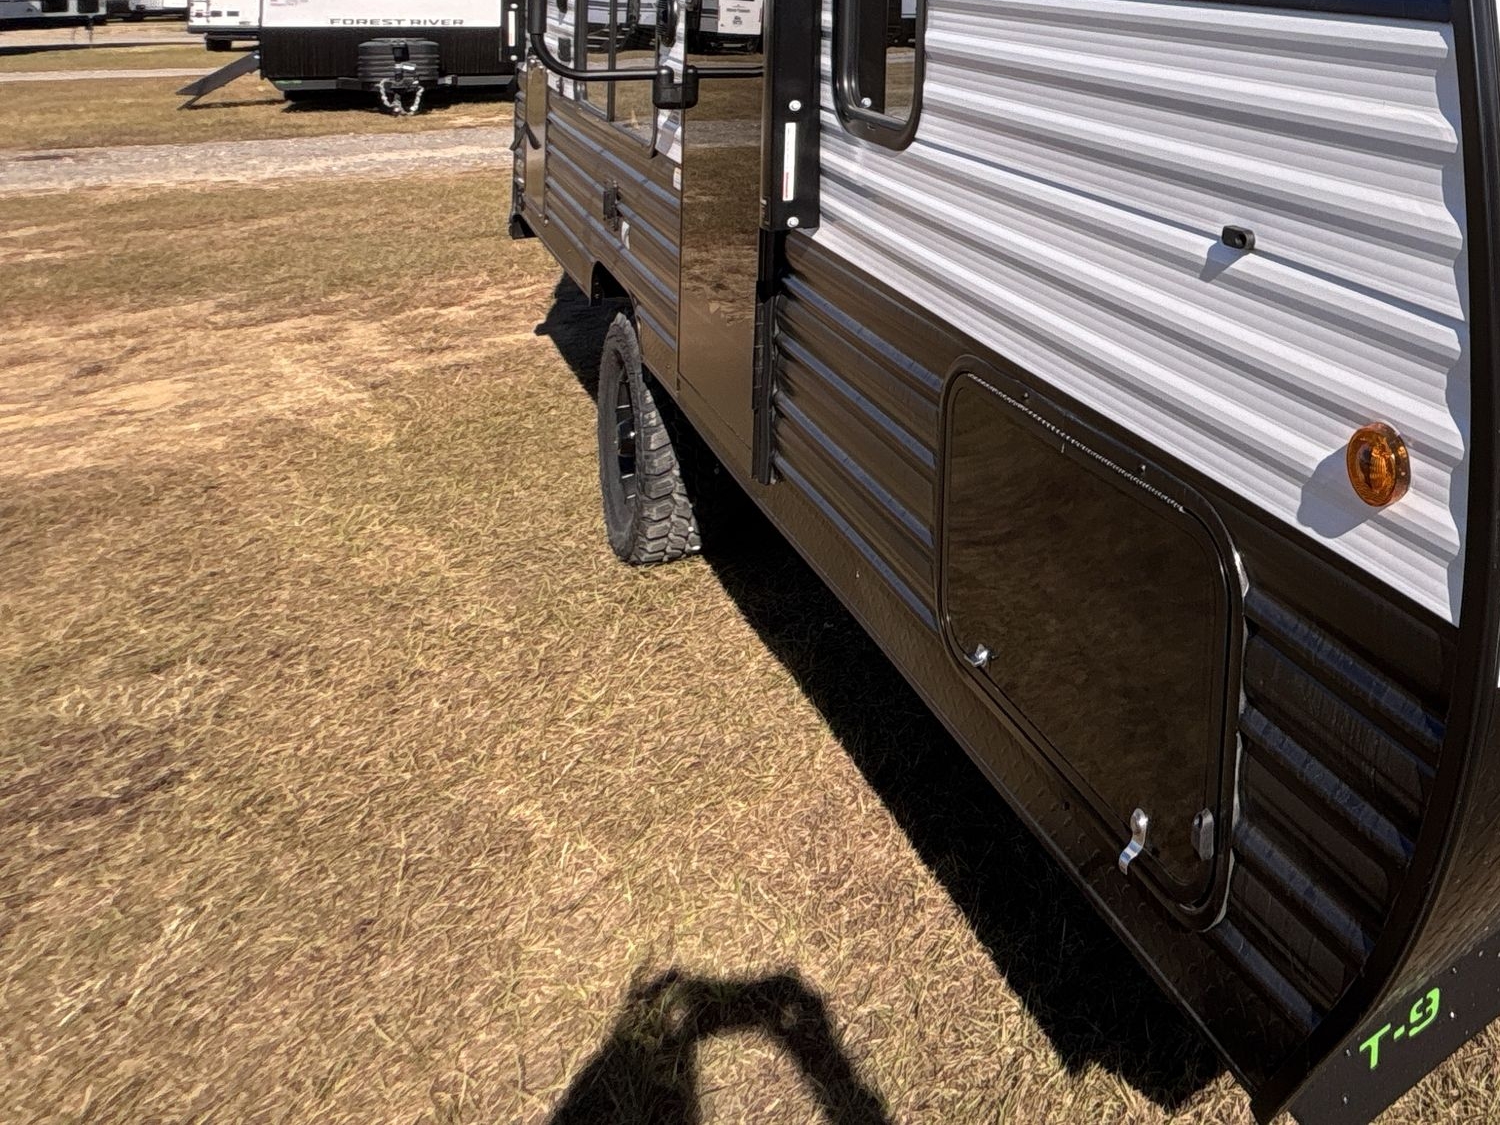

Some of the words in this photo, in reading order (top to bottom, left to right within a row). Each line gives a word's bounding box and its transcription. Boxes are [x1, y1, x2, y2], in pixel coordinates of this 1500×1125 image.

[329, 18, 406, 26] FOREST
[409, 18, 464, 26] RIVER
[1359, 987, 1440, 1070] T-9
